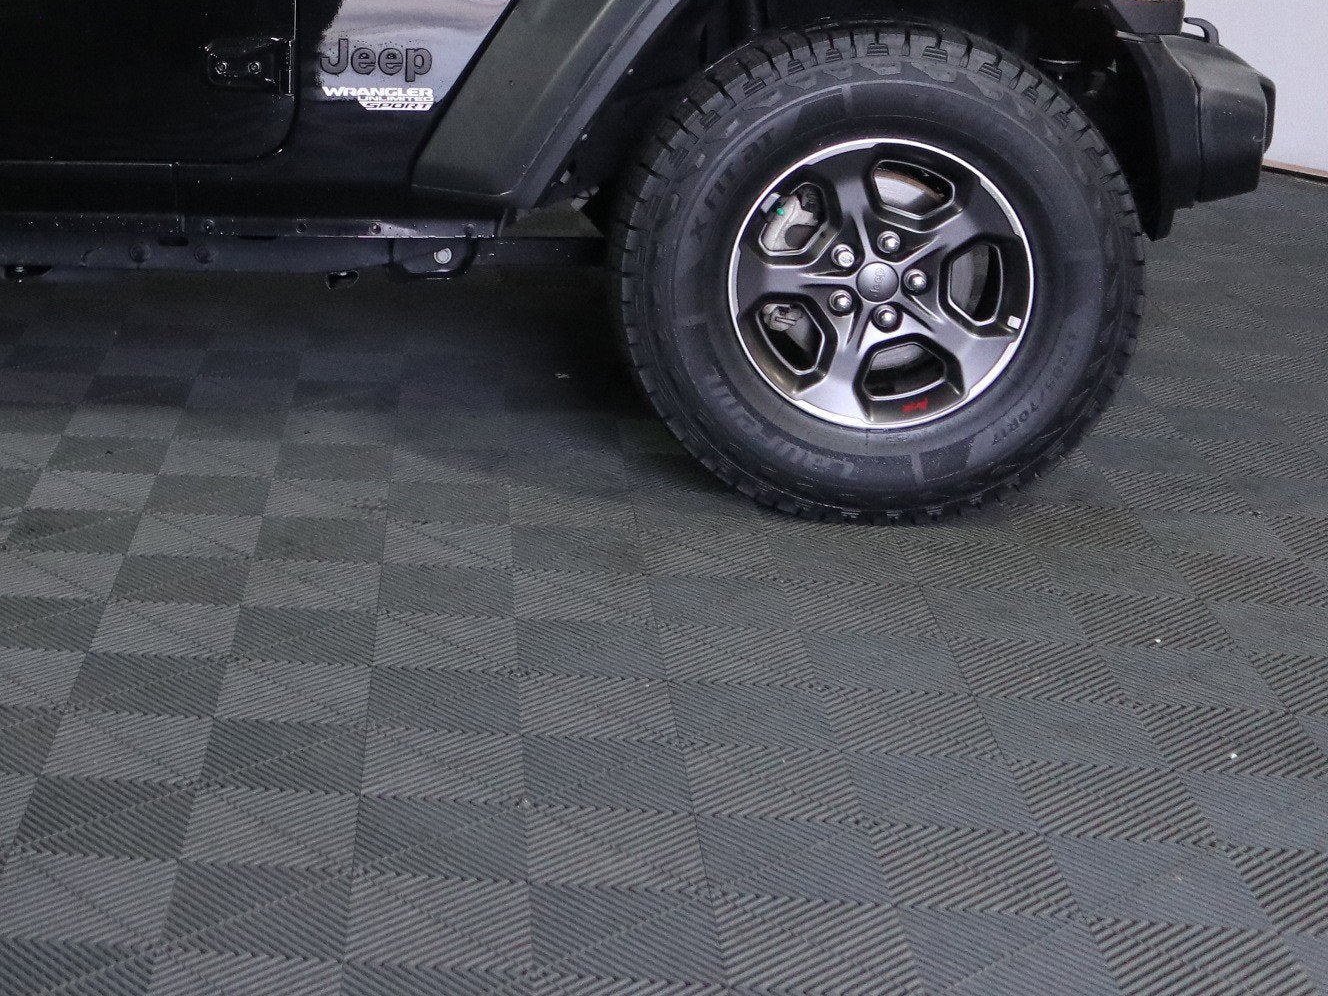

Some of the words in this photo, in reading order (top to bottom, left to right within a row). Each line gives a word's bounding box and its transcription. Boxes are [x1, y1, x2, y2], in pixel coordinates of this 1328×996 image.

[320, 38, 433, 82] Jeep
[322, 86, 434, 97] WRANGLER
[365, 102, 428, 110] SPORT
